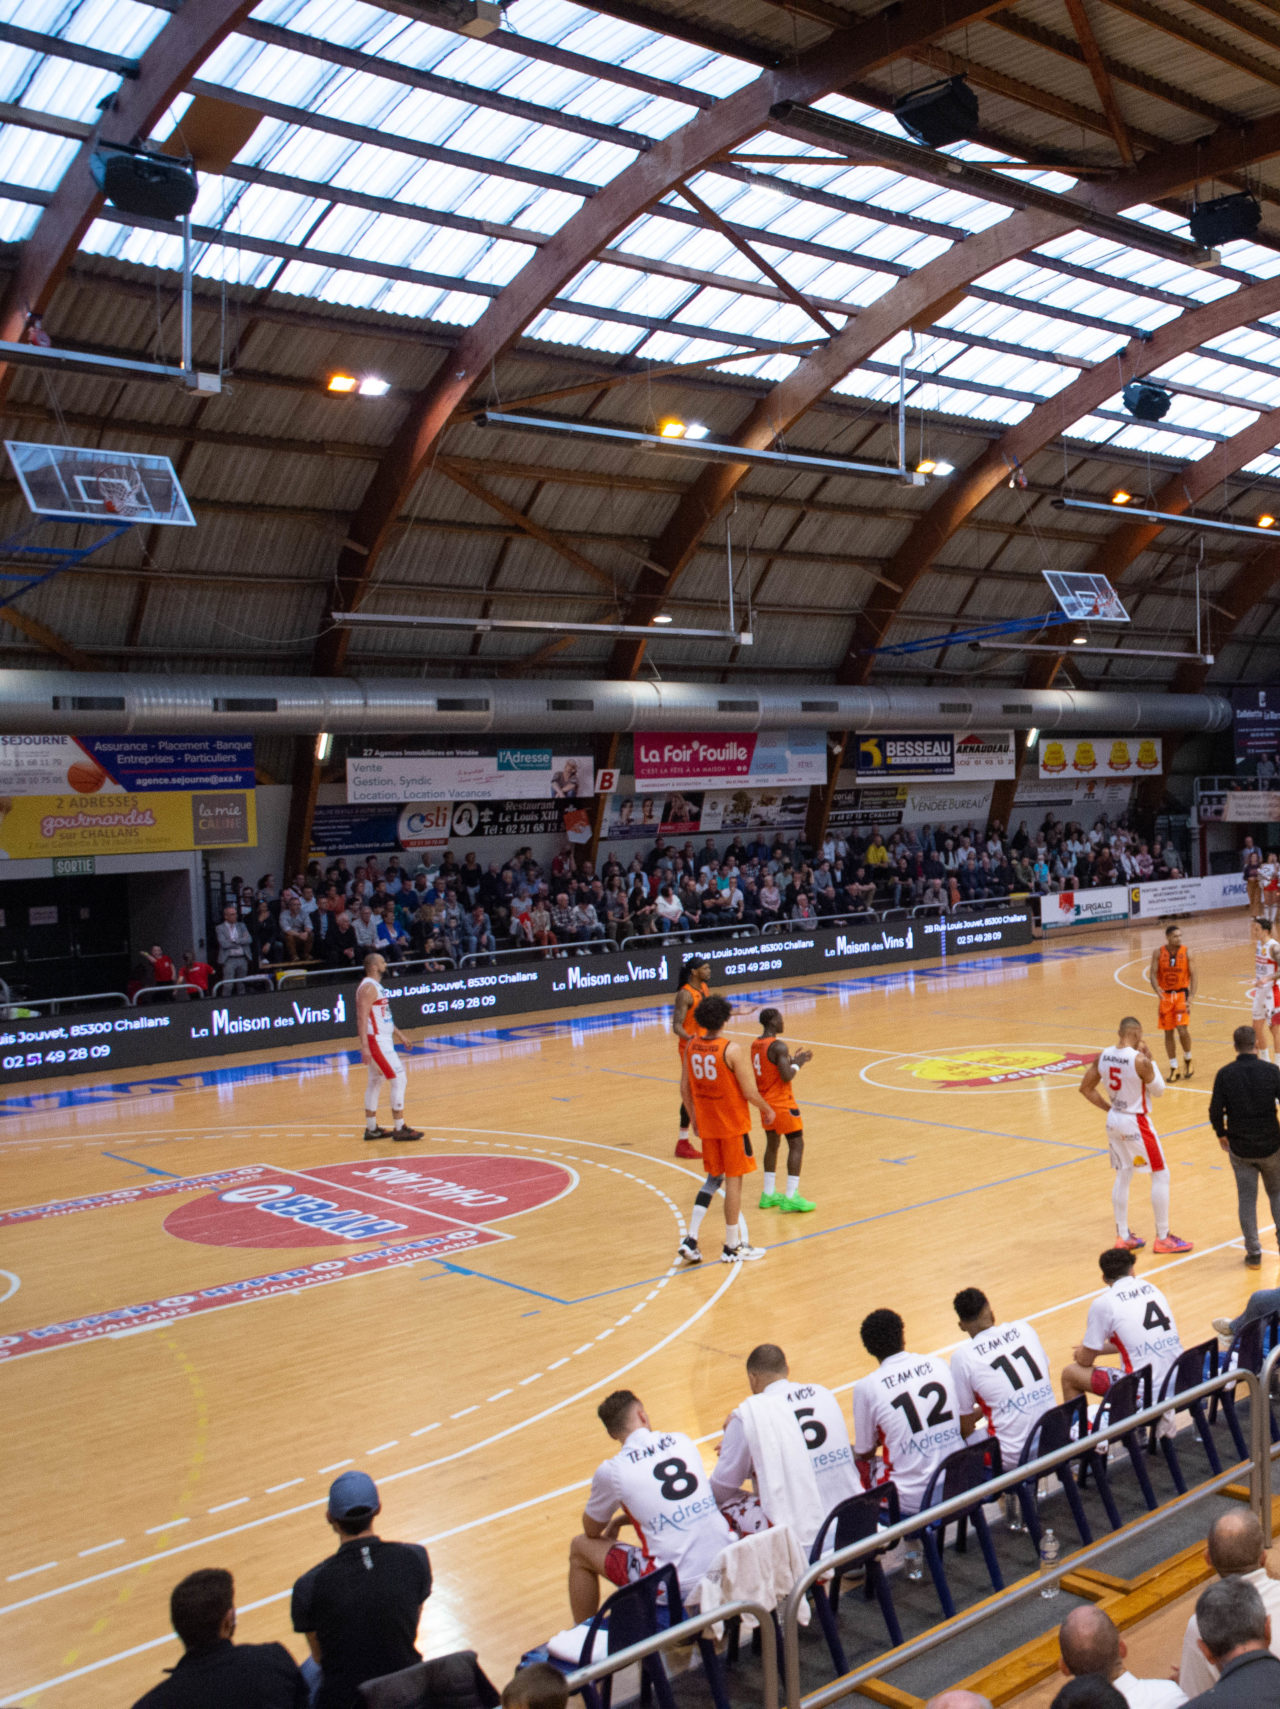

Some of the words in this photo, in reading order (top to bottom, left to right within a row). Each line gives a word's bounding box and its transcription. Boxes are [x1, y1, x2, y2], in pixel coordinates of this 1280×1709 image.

[94, 741, 147, 751] Assurance
[158, 740, 210, 750] Placement
[363, 748, 374, 756] 27
[640, 745, 660, 762] La
[887, 741, 951, 757] BESSEAU
[956, 743, 1009, 753] ARNAUDEAU
[117, 754, 174, 765] Entreprises
[184, 753, 236, 763] Particuliers
[352, 763, 383, 772] Vente
[499, 751, 551, 768] l'Adresse
[136, 774, 242, 786] agence.sejourne@axa.fr
[353, 776, 396, 786] Gestion,
[399, 776, 432, 787] Syndic
[600, 772, 614, 790] B
[57, 798, 64, 809] 2
[69, 796, 138, 808] ADRESSES
[353, 791, 400, 801] Location,
[403, 790, 445, 799] Location
[448, 789, 492, 799] Vacances
[199, 804, 213, 817] la
[215, 803, 242, 816] mie
[499, 812, 511, 822] Le
[514, 812, 539, 821] Louis
[541, 810, 558, 820] XIII
[505, 801, 555, 811] Restaurant
[43, 809, 155, 838] gourmandes
[506, 825, 517, 834] 02
[519, 824, 530, 833] 51
[532, 823, 545, 832] 68
[60, 832, 76, 840] sur
[81, 828, 140, 839] CHALLANS
[56, 858, 92, 875] SORTIE
[712, 948, 732, 959] Louis
[761, 942, 783, 953] 85300
[784, 939, 814, 950] Challans
[824, 948, 836, 957] La
[836, 935, 870, 956] Maison
[882, 931, 905, 949] Vins
[552, 981, 566, 991] La
[567, 966, 611, 990] Maison
[613, 974, 630, 984] des
[627, 960, 657, 981] Vins
[725, 965, 736, 975] 02
[737, 964, 746, 973] 51
[747, 962, 758, 972] 49
[759, 960, 770, 970] 28
[771, 959, 782, 969] 09
[404, 984, 431, 996] Louis
[431, 979, 467, 992] Jouvet,
[467, 976, 497, 988] 85300
[498, 971, 538, 984] Challans
[421, 1003, 436, 1014] 02
[437, 1001, 449, 1012] 51
[450, 999, 465, 1010] 49
[466, 997, 480, 1008] 28
[481, 995, 496, 1006] 09
[17, 1027, 69, 1043] Jouvet,
[70, 1022, 113, 1037] 85300
[114, 1016, 170, 1031] Challans
[191, 1027, 209, 1038] La
[212, 1009, 270, 1036] Maison
[274, 1016, 295, 1028] des
[293, 1001, 331, 1024] Vins
[3, 1055, 24, 1070] 02
[26, 1052, 42, 1067] 51
[45, 1050, 66, 1064] 49
[68, 1047, 88, 1061] 28
[90, 1044, 111, 1058] 09
[690, 1053, 718, 1081] 66
[752, 1053, 762, 1076] 4
[1108, 1066, 1122, 1091] 5
[177, 1174, 260, 1192] CHALLANS
[352, 1166, 508, 1207] CHALLANS
[42, 1198, 136, 1218] CHALLANS
[256, 1194, 408, 1240] HYPER
[349, 1237, 449, 1262] HYPER
[387, 1239, 478, 1264] CHALLANS
[200, 1267, 312, 1298] HYPER
[241, 1270, 344, 1299] CHALLANS
[1116, 1287, 1143, 1303] TEAM
[71, 1306, 191, 1339] CHALLANS
[1142, 1300, 1171, 1332] 4
[974, 1339, 1003, 1356] TEAM
[881, 1368, 913, 1389] TEAM
[990, 1346, 1043, 1391] 11
[891, 1381, 954, 1435] 12
[626, 1444, 655, 1464] TEAM
[653, 1457, 698, 1501] 8
